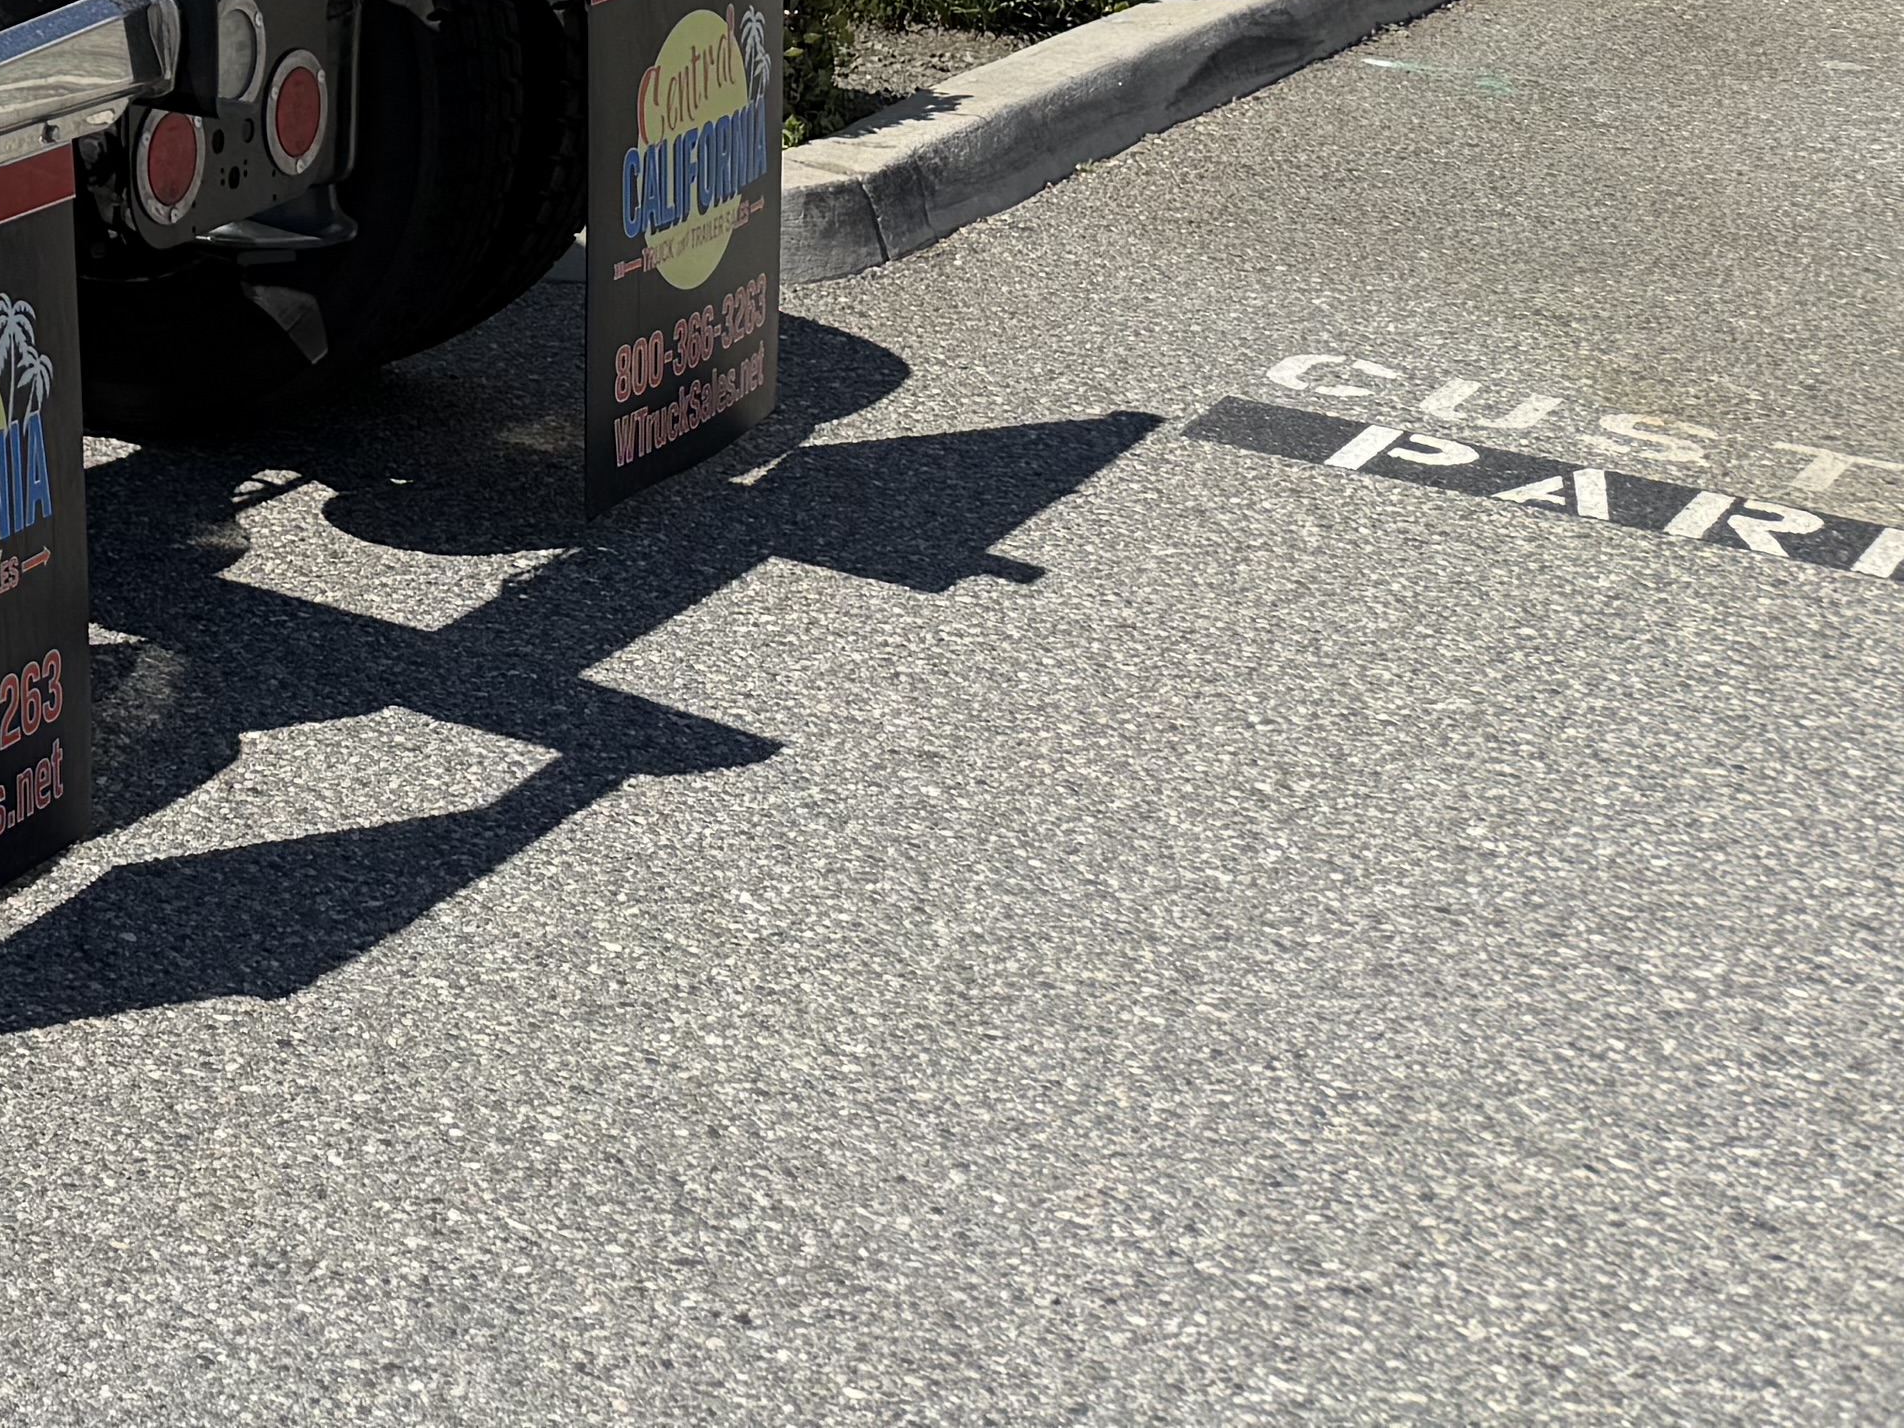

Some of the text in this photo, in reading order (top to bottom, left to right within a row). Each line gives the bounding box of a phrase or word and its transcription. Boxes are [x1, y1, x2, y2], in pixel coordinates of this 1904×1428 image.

[637, 2, 735, 145] Central
[622, 95, 768, 238] CALIFORNIA
[692, 216, 724, 249] TRAILER
[613, 270, 767, 405] 800-366-3263
[614, 338, 765, 469] WTruckSales.net
[1265, 352, 1904, 493] CUST
